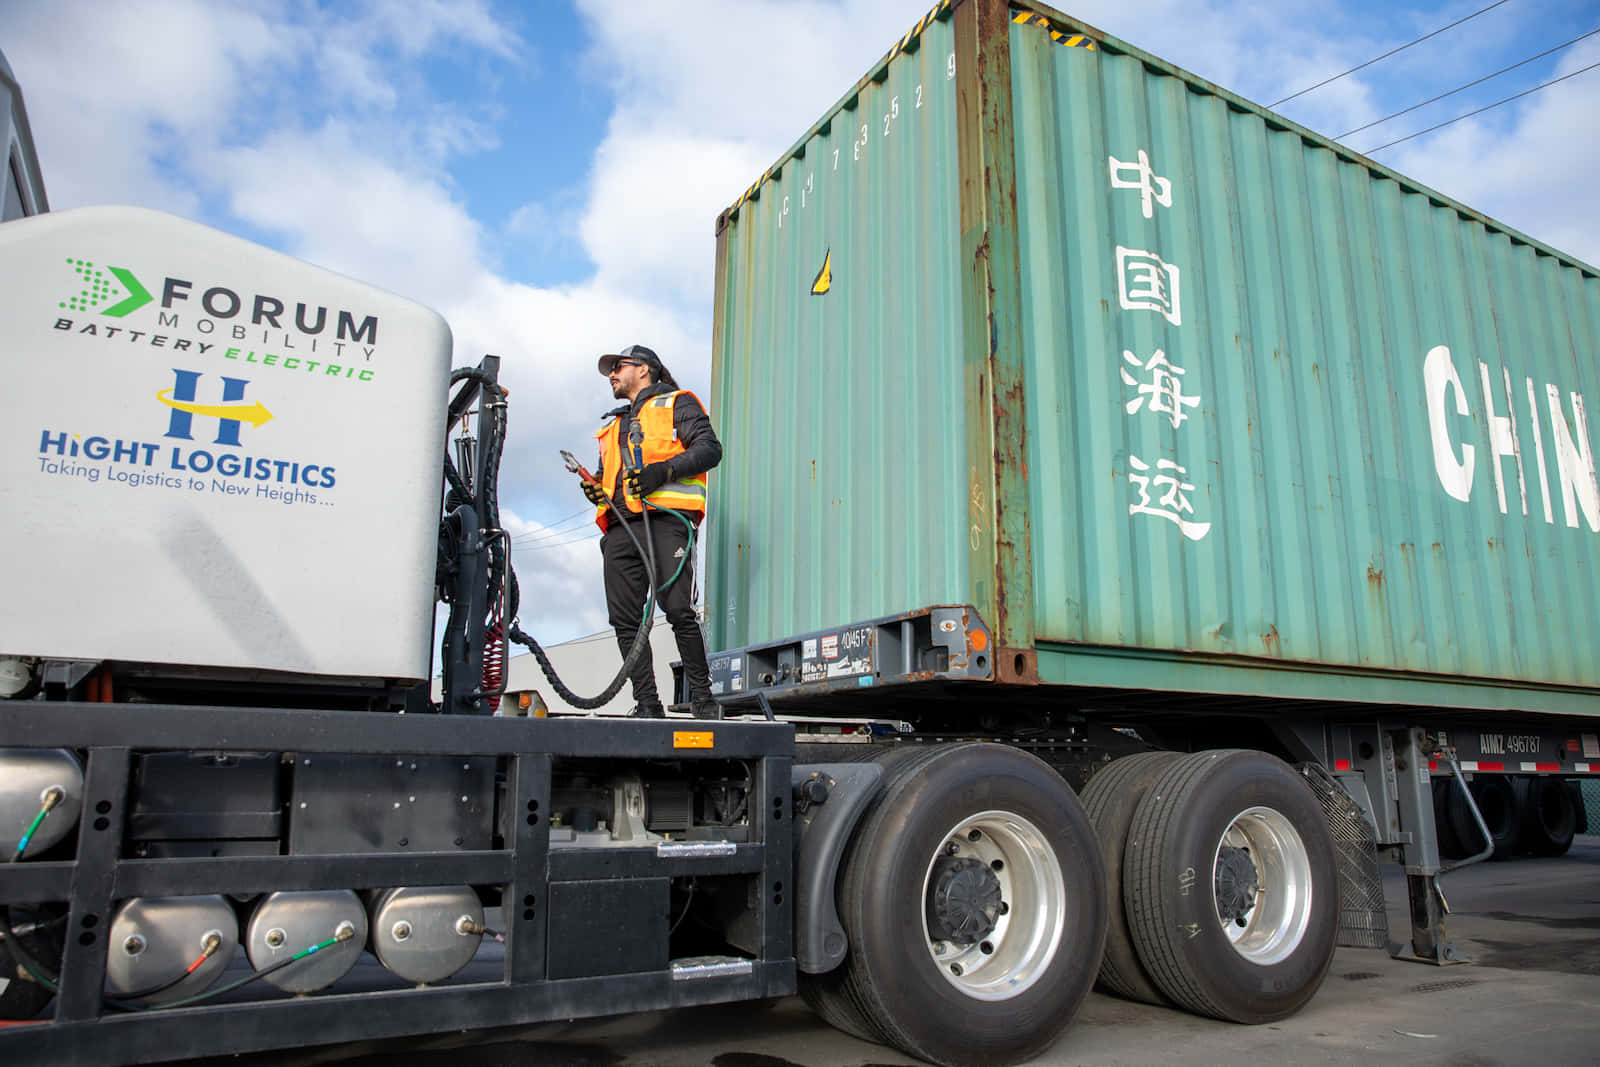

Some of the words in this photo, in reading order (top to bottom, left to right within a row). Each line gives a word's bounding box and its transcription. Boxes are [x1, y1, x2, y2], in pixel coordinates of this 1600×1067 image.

[160, 277, 379, 345] FORUM
[53, 317, 215, 354] BATTERY
[224, 347, 376, 382] ELECTRIC
[158, 312, 375, 361] MOBILITY
[1108, 149, 1212, 541] 中国海运
[39, 457, 100, 482] Taking
[107, 467, 182, 490] Logistics
[189, 478, 205, 491] to
[212, 479, 250, 496] New
[171, 447, 337, 488] LOGISTICS
[1507, 735, 1540, 753] 496787
